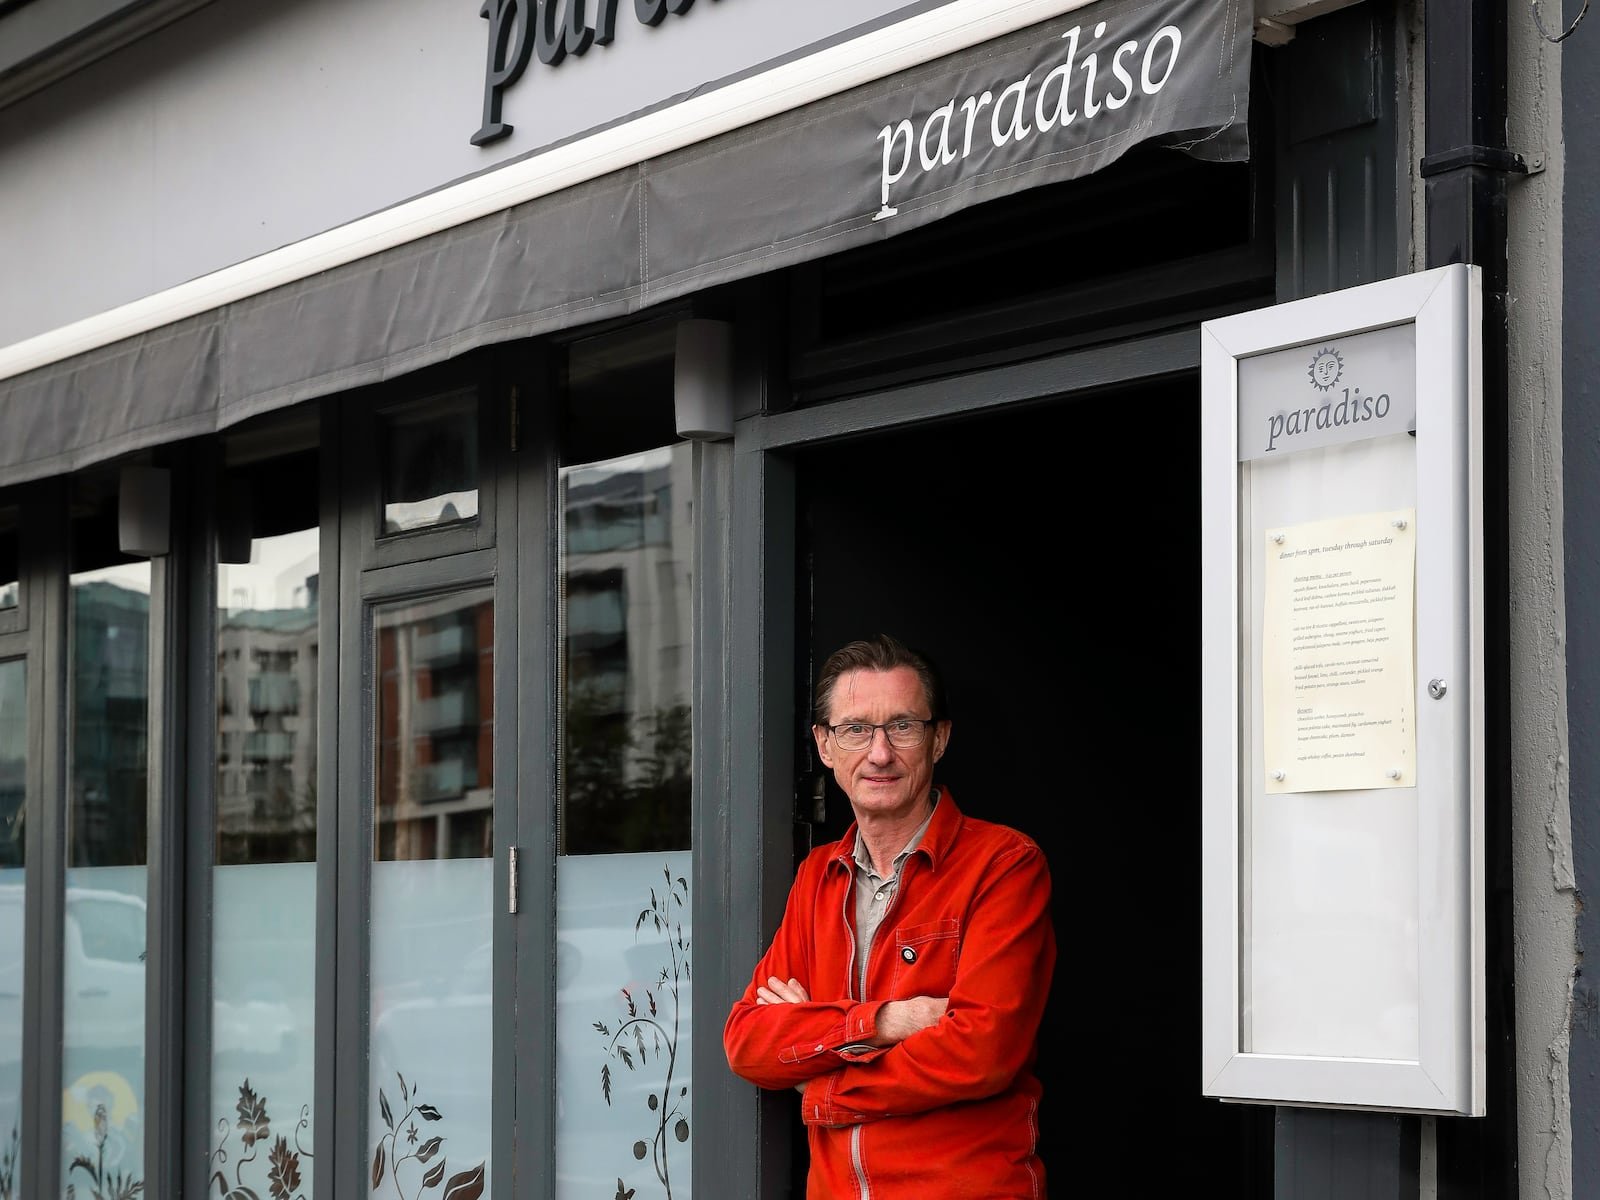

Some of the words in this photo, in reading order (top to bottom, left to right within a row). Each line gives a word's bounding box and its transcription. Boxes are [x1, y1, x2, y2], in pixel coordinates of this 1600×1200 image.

[872, 21, 1182, 221] paradiso
[1265, 388, 1391, 452] paradiso
[1322, 543, 1344, 552] tuesday
[1344, 540, 1368, 550] through
[1368, 536, 1393, 547] saturday
